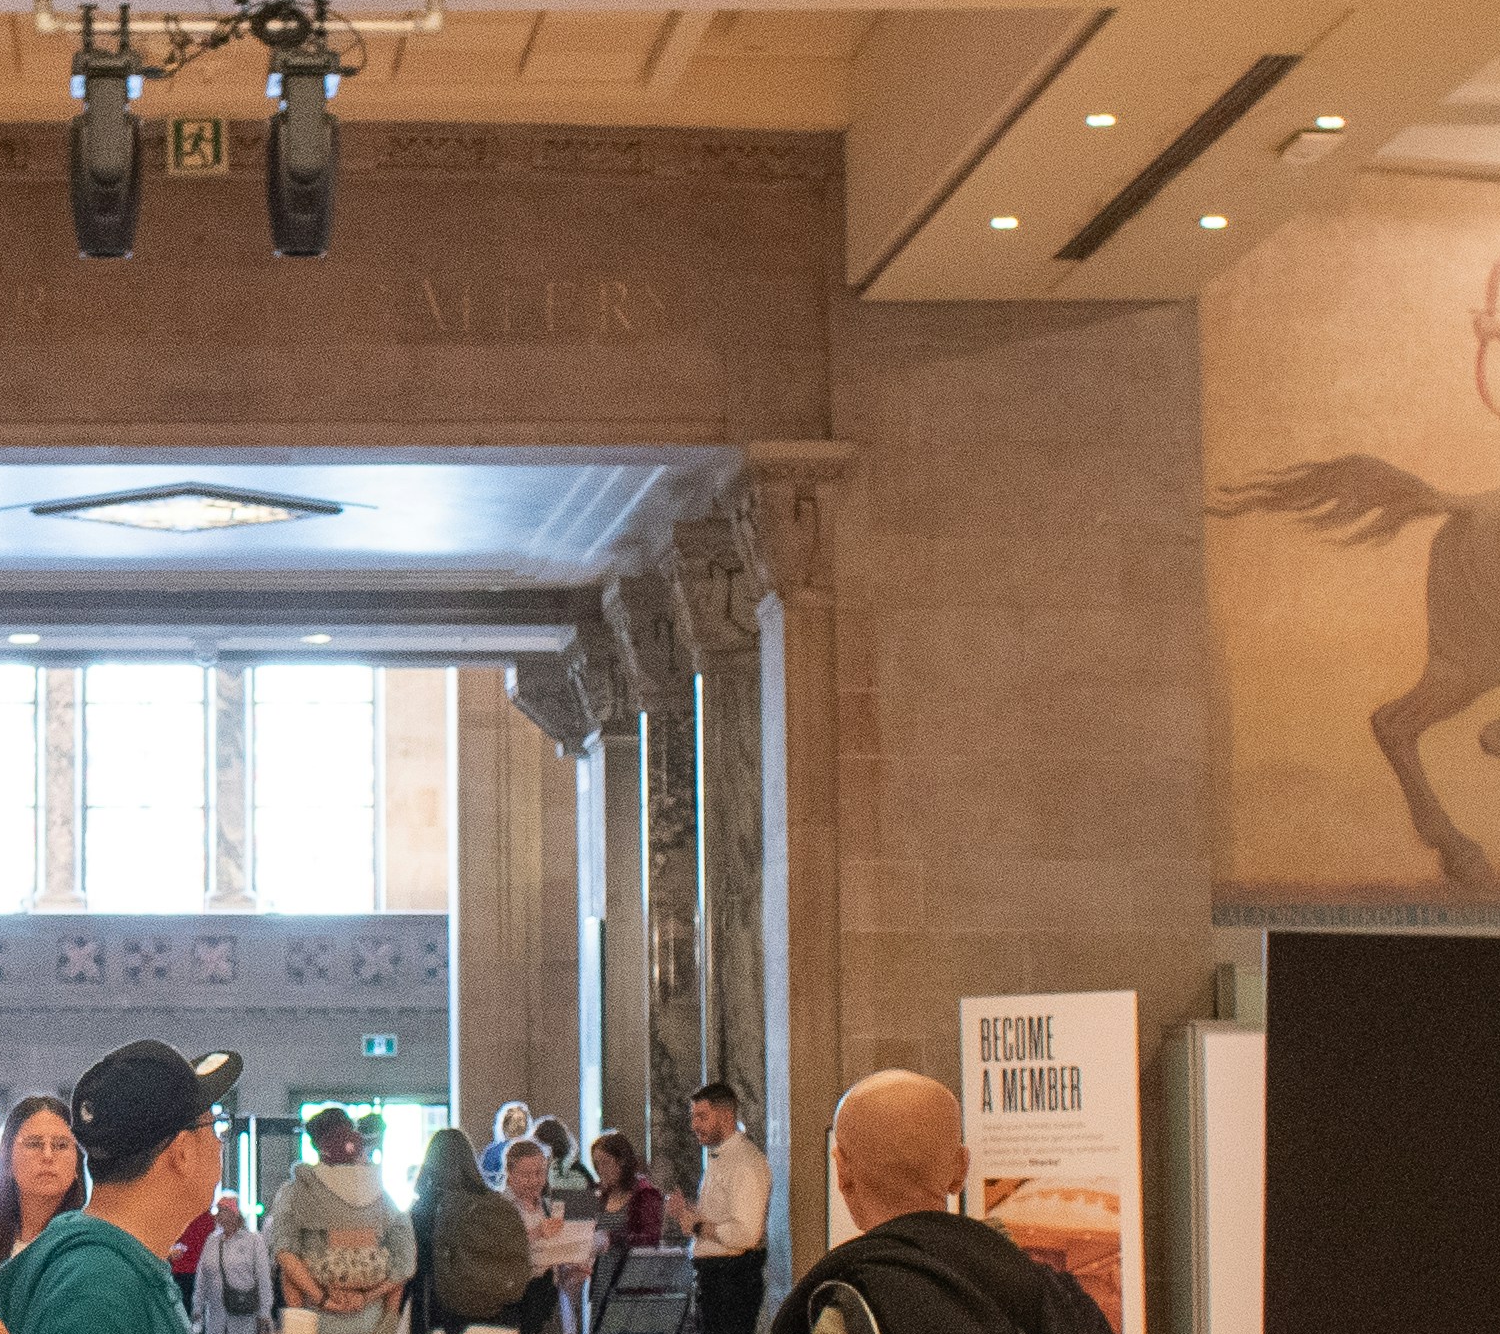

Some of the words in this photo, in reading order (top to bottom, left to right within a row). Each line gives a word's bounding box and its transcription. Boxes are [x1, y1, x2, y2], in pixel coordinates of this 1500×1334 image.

[979, 1015, 1054, 1063] BECOME
[981, 1067, 994, 1114] A
[1001, 1065, 1083, 1114] MEMBER
